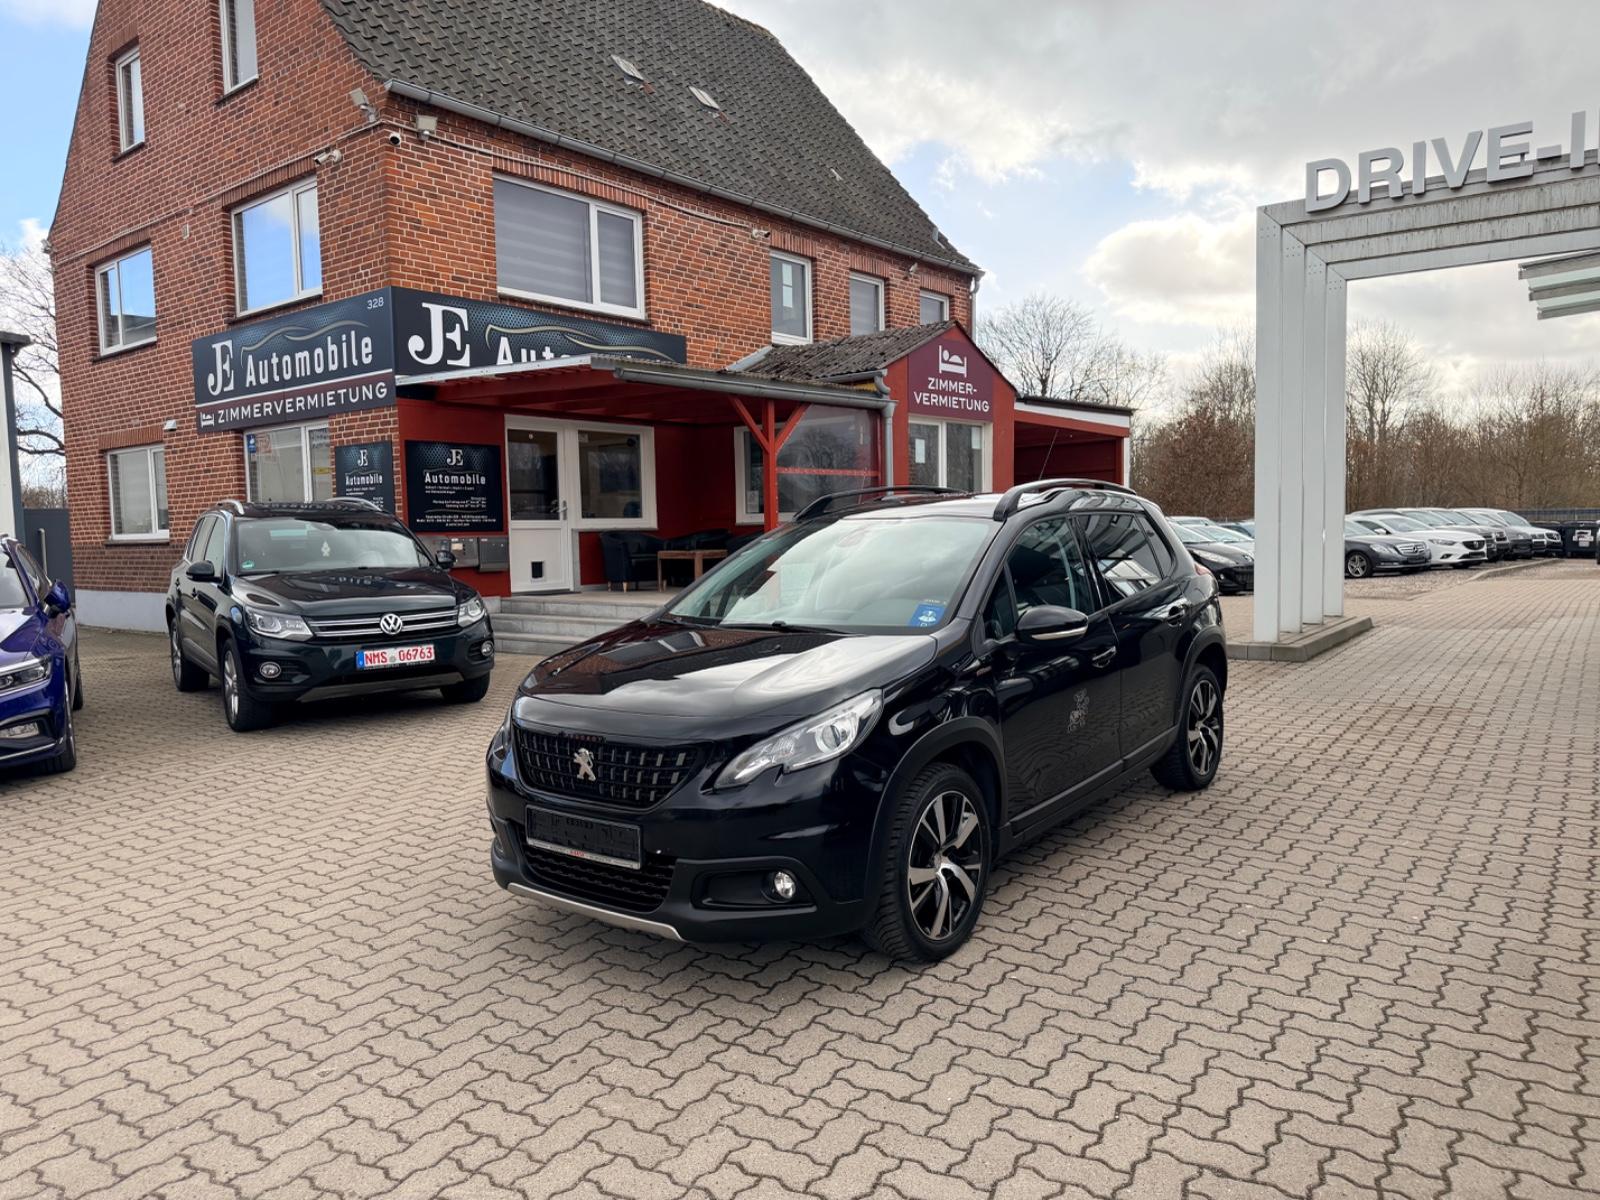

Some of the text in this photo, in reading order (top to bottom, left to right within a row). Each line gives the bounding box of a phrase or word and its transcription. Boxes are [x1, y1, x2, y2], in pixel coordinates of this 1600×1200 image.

[1306, 107, 1600, 213] DRIVE-I
[367, 296, 384, 310] 328
[407, 302, 470, 367] JE
[207, 330, 373, 396] JE Automobile
[927, 377, 978, 395] ZIMMER-
[217, 381, 388, 424] ZIMMERVERMIETUNG
[913, 391, 990, 413] VERMIETUNG
[446, 449, 464, 466] JE
[425, 472, 486, 485] Automobile
[364, 646, 433, 665] NMS 06763
